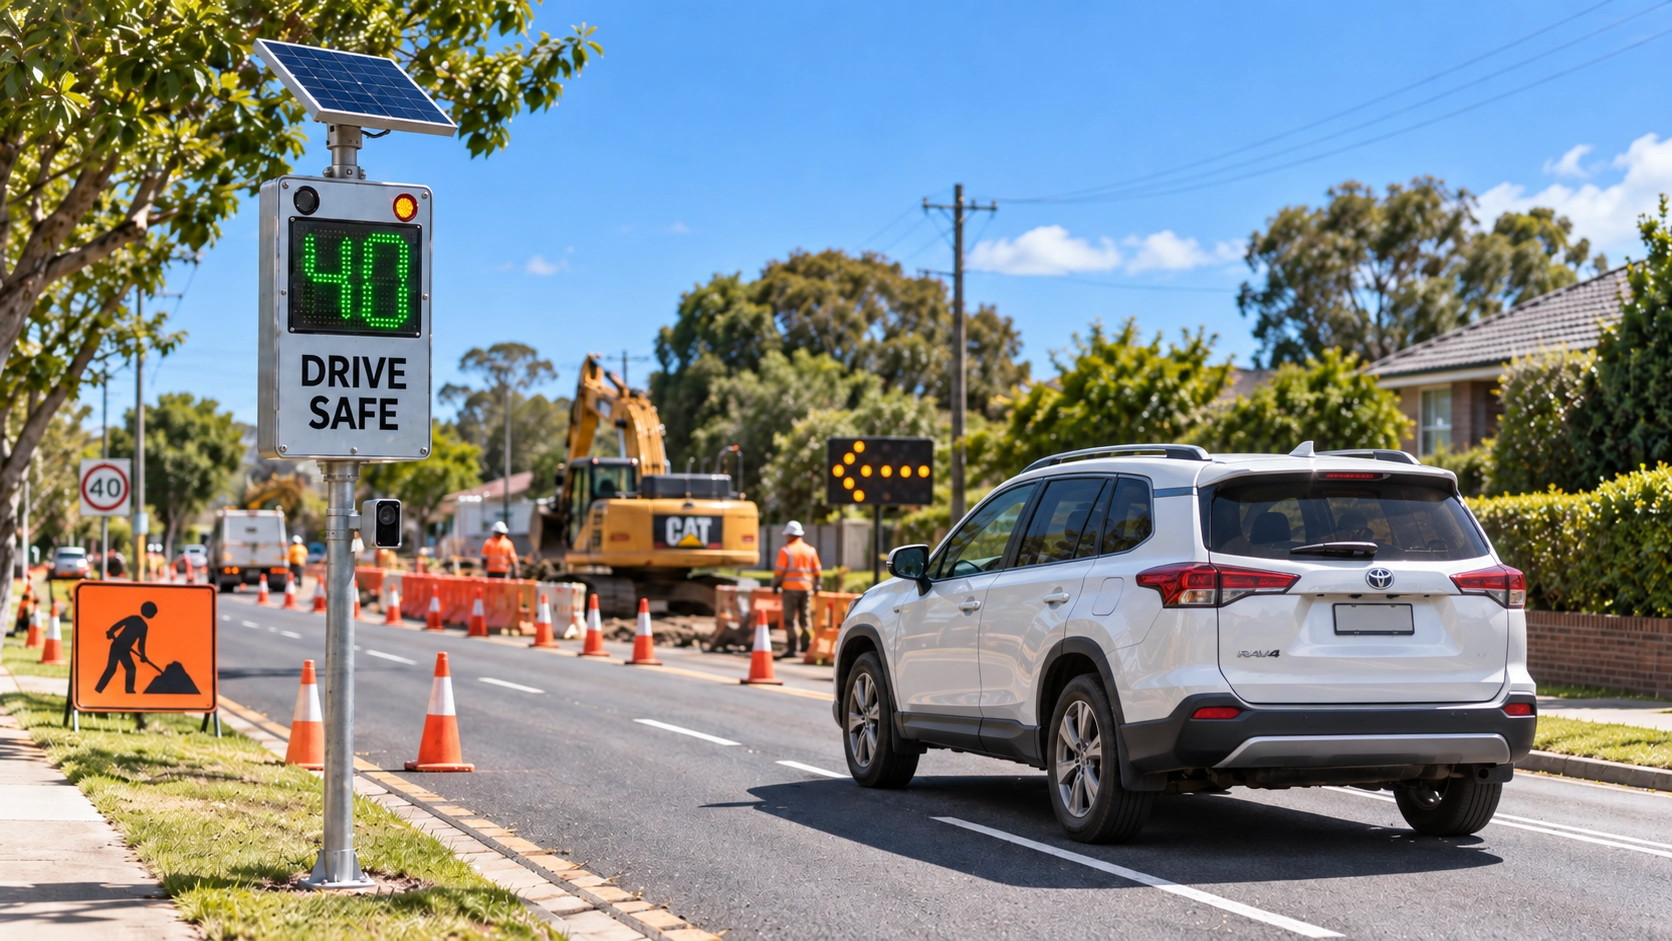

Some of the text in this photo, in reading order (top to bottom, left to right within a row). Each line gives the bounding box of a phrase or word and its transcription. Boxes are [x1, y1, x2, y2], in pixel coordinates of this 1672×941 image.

[304, 233, 408, 328] 40
[301, 354, 407, 389] DRIVE
[308, 395, 399, 430] SAFE
[89, 477, 121, 498] 40
[665, 515, 712, 547] CAT
[1237, 649, 1280, 658] RAV4
